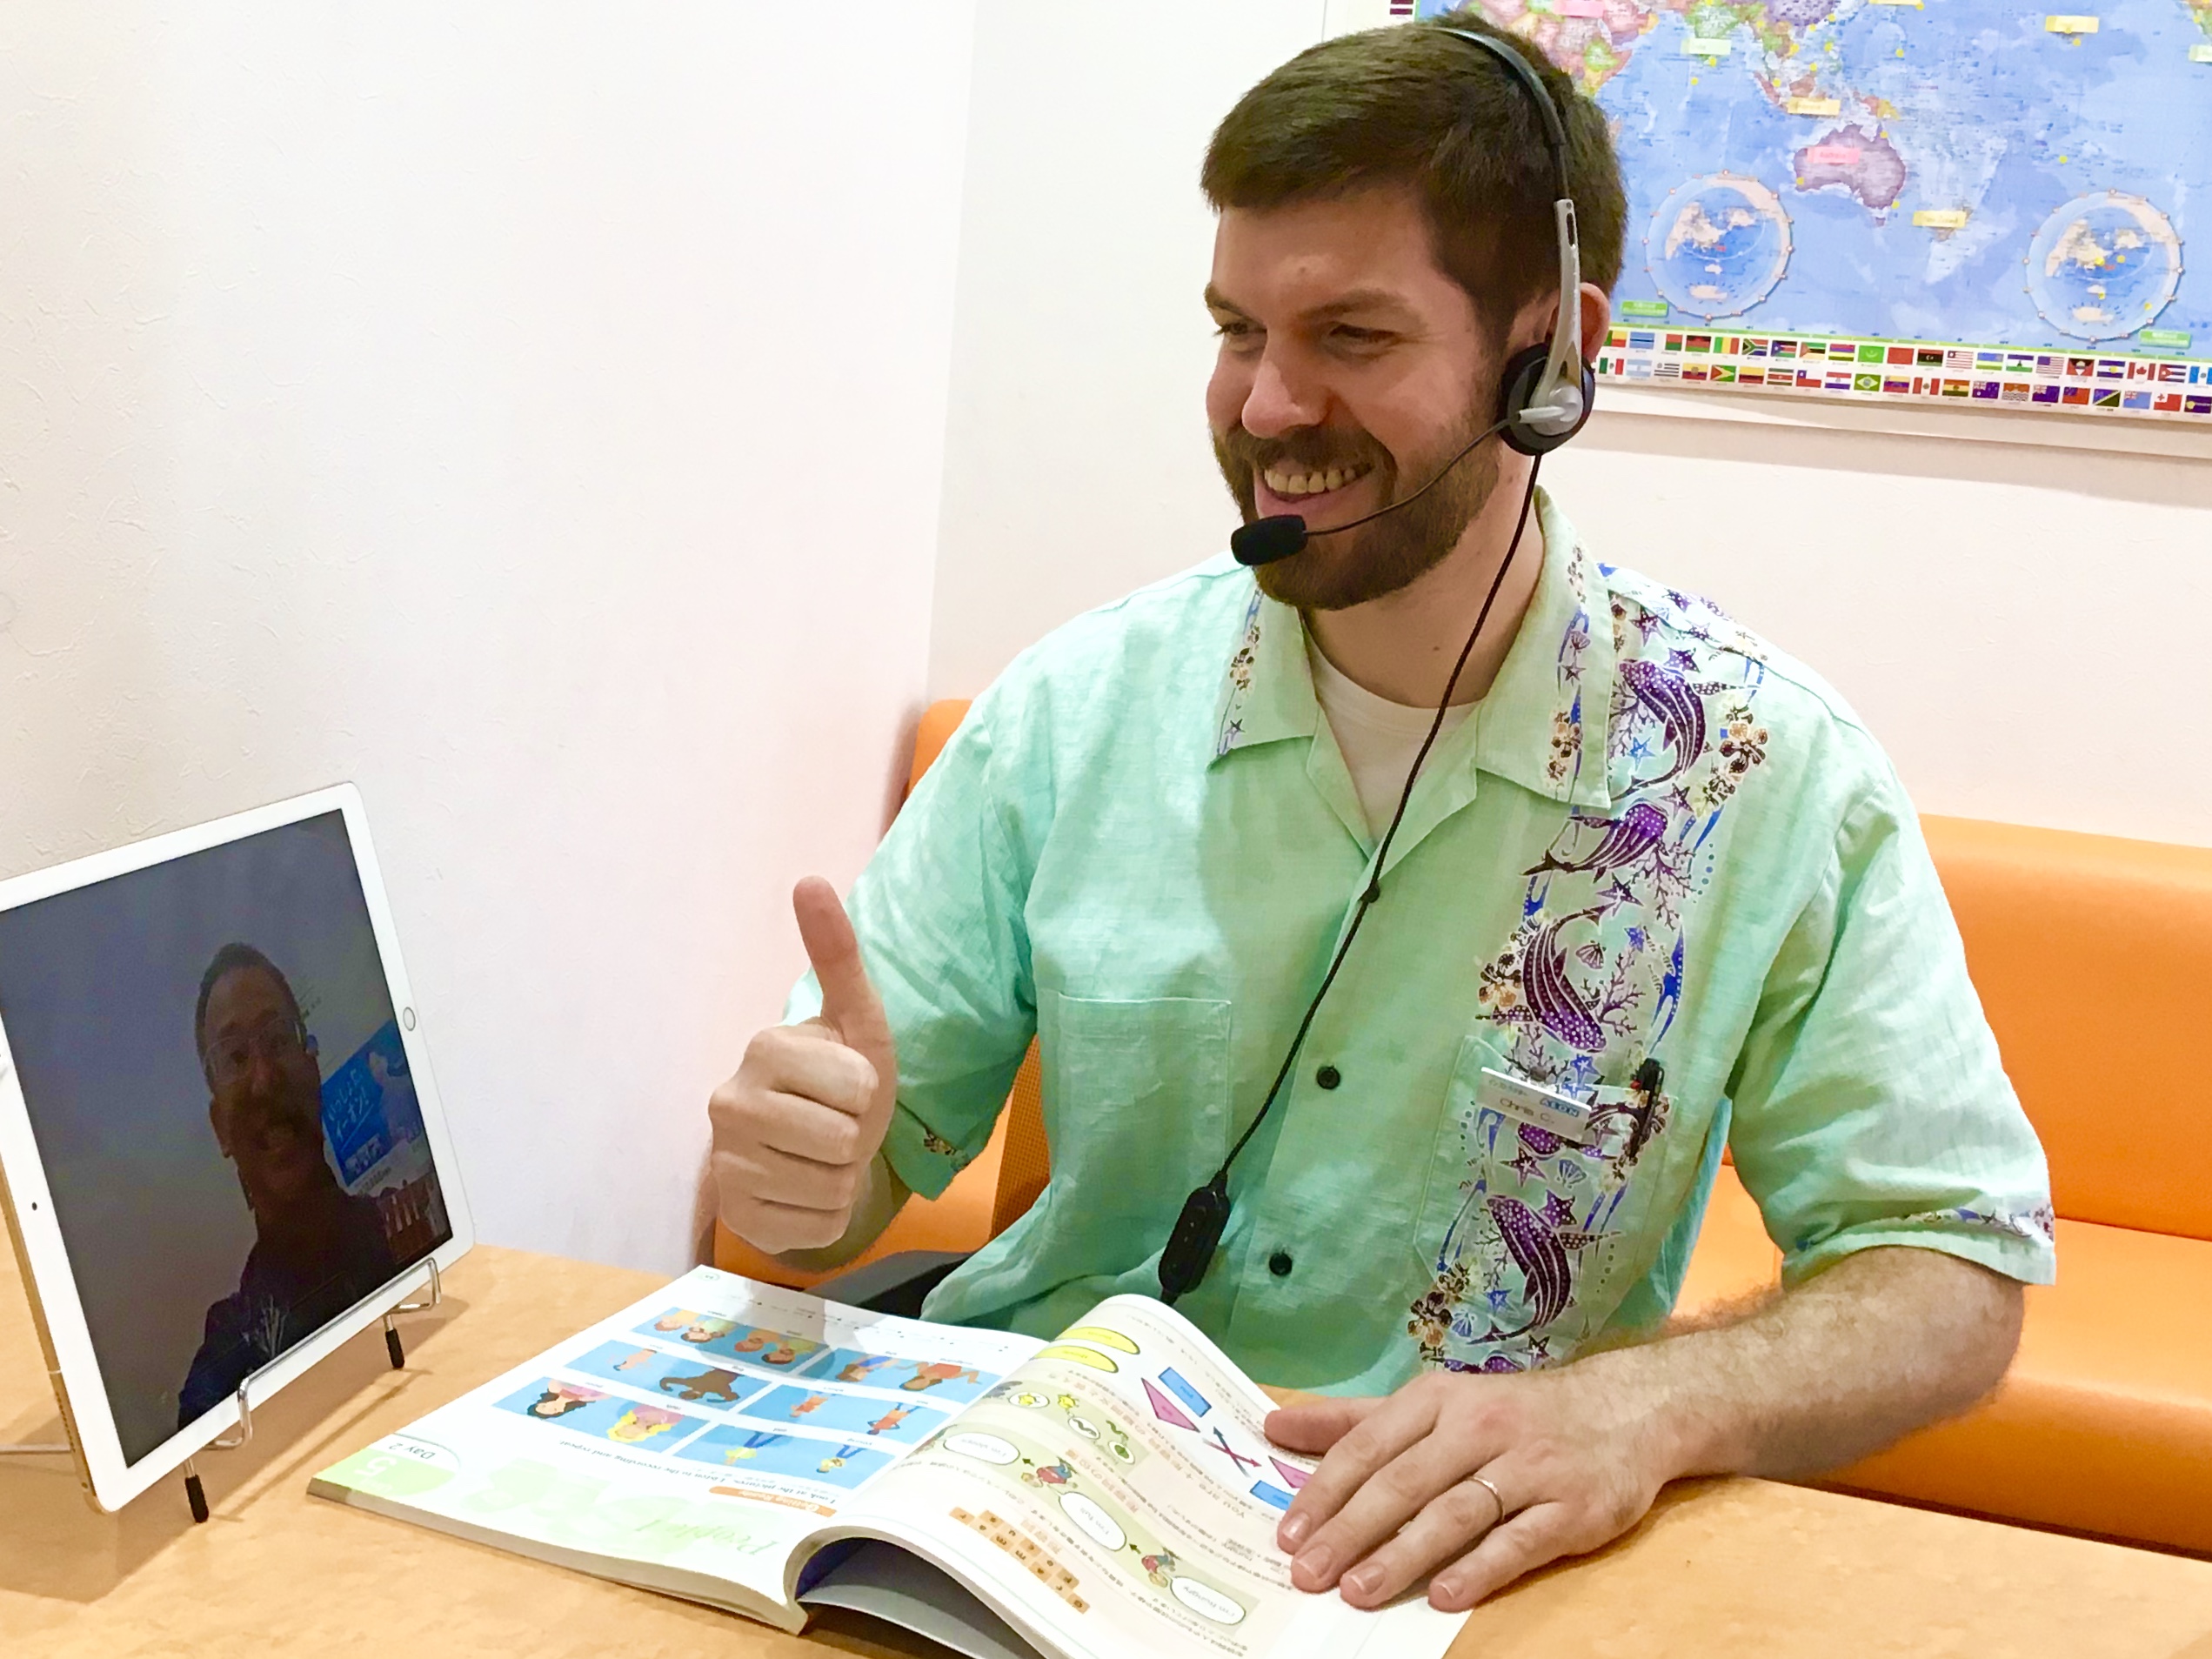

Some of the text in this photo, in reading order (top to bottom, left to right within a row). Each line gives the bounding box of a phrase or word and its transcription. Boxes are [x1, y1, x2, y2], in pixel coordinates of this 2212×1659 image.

[1500, 1099, 1534, 1116] Chris
[1540, 1098, 1579, 1117] AEON
[389, 1442, 436, 1460] Day 2
[591, 1448, 611, 1459] and
[356, 1456, 396, 1475] 5
[614, 1455, 661, 1470] recording
[665, 1467, 679, 1475] the
[1223, 1501, 1245, 1518] You
